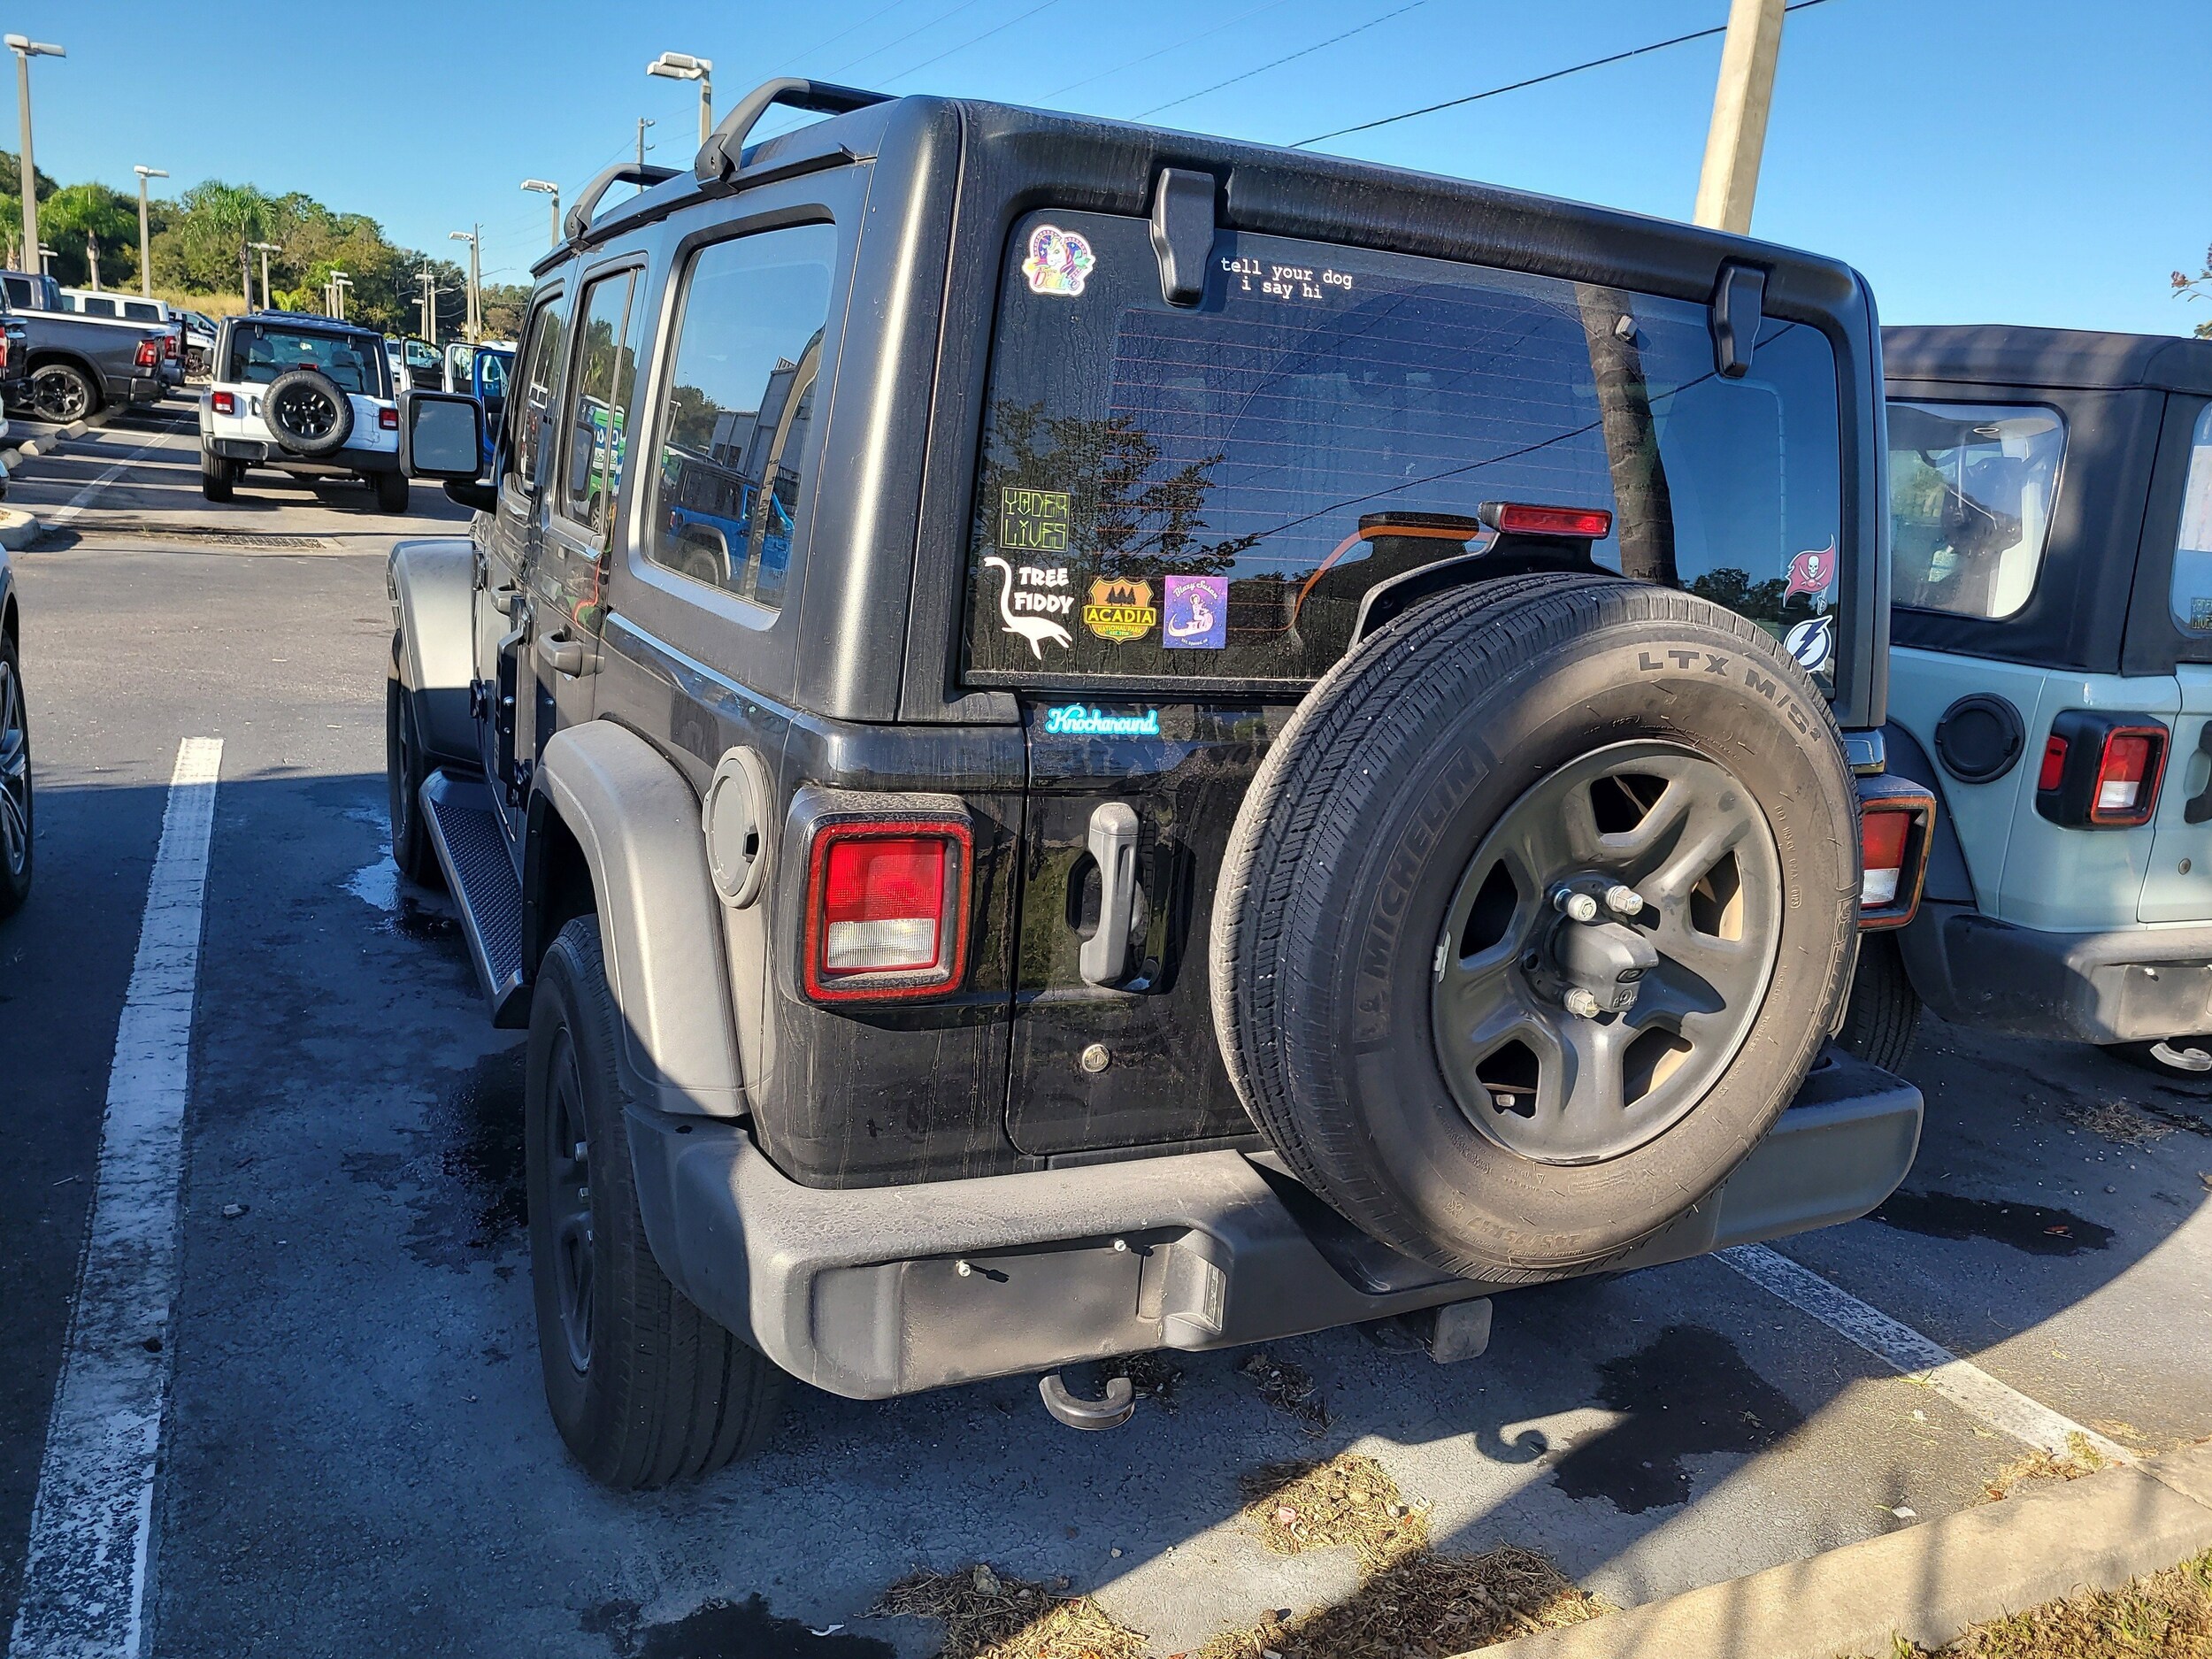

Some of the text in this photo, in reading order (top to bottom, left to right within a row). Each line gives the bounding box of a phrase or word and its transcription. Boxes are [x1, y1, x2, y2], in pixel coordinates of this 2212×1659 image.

[1221, 257, 1353, 290] tell your dog
[1241, 275, 1323, 300] i say hi
[1004, 489, 1067, 519] YODER
[1018, 566, 1070, 588] TREE
[1013, 591, 1075, 614] FIDDY
[1087, 608, 1153, 624] ACADIA
[1127, 626, 1143, 634] PARK
[1637, 649, 1729, 677] LTX
[1046, 704, 1160, 734] Knockaround
[1363, 749, 1478, 979] MICHELIN
